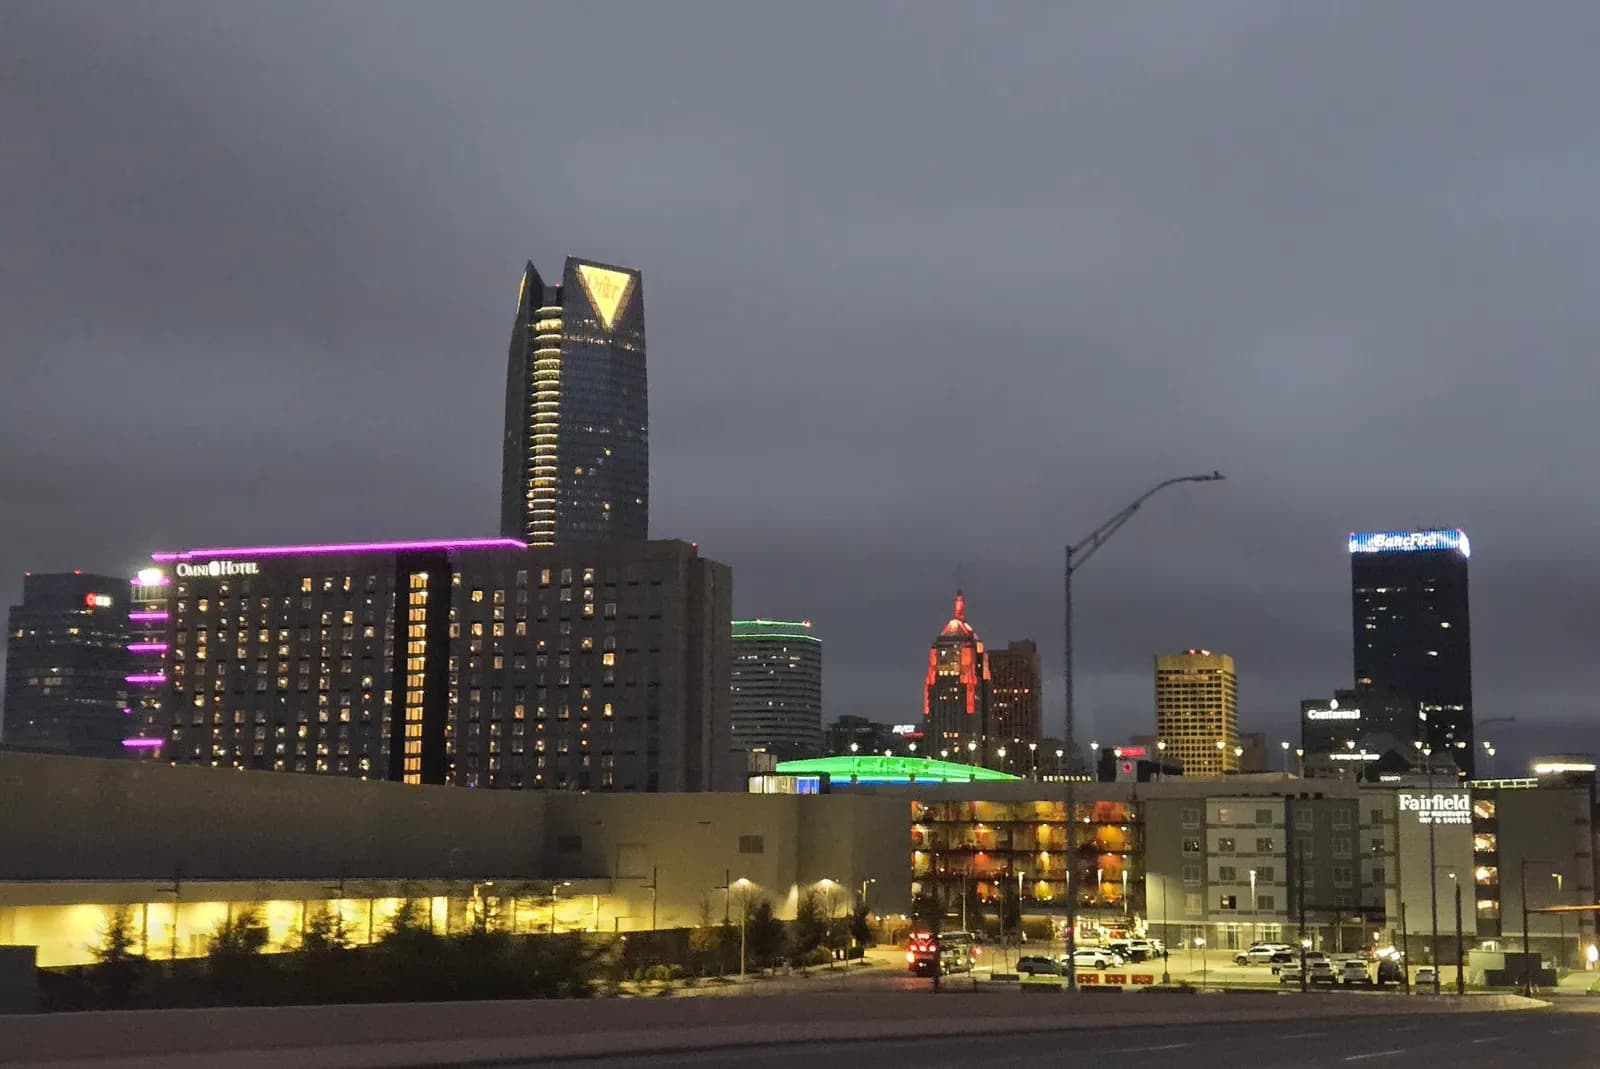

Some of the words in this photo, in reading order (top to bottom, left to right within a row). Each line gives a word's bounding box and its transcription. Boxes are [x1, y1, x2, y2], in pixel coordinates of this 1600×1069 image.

[176, 563, 208, 577] OMNI
[220, 560, 259, 575] HOTEL
[1399, 794, 1470, 811] Fairfield
